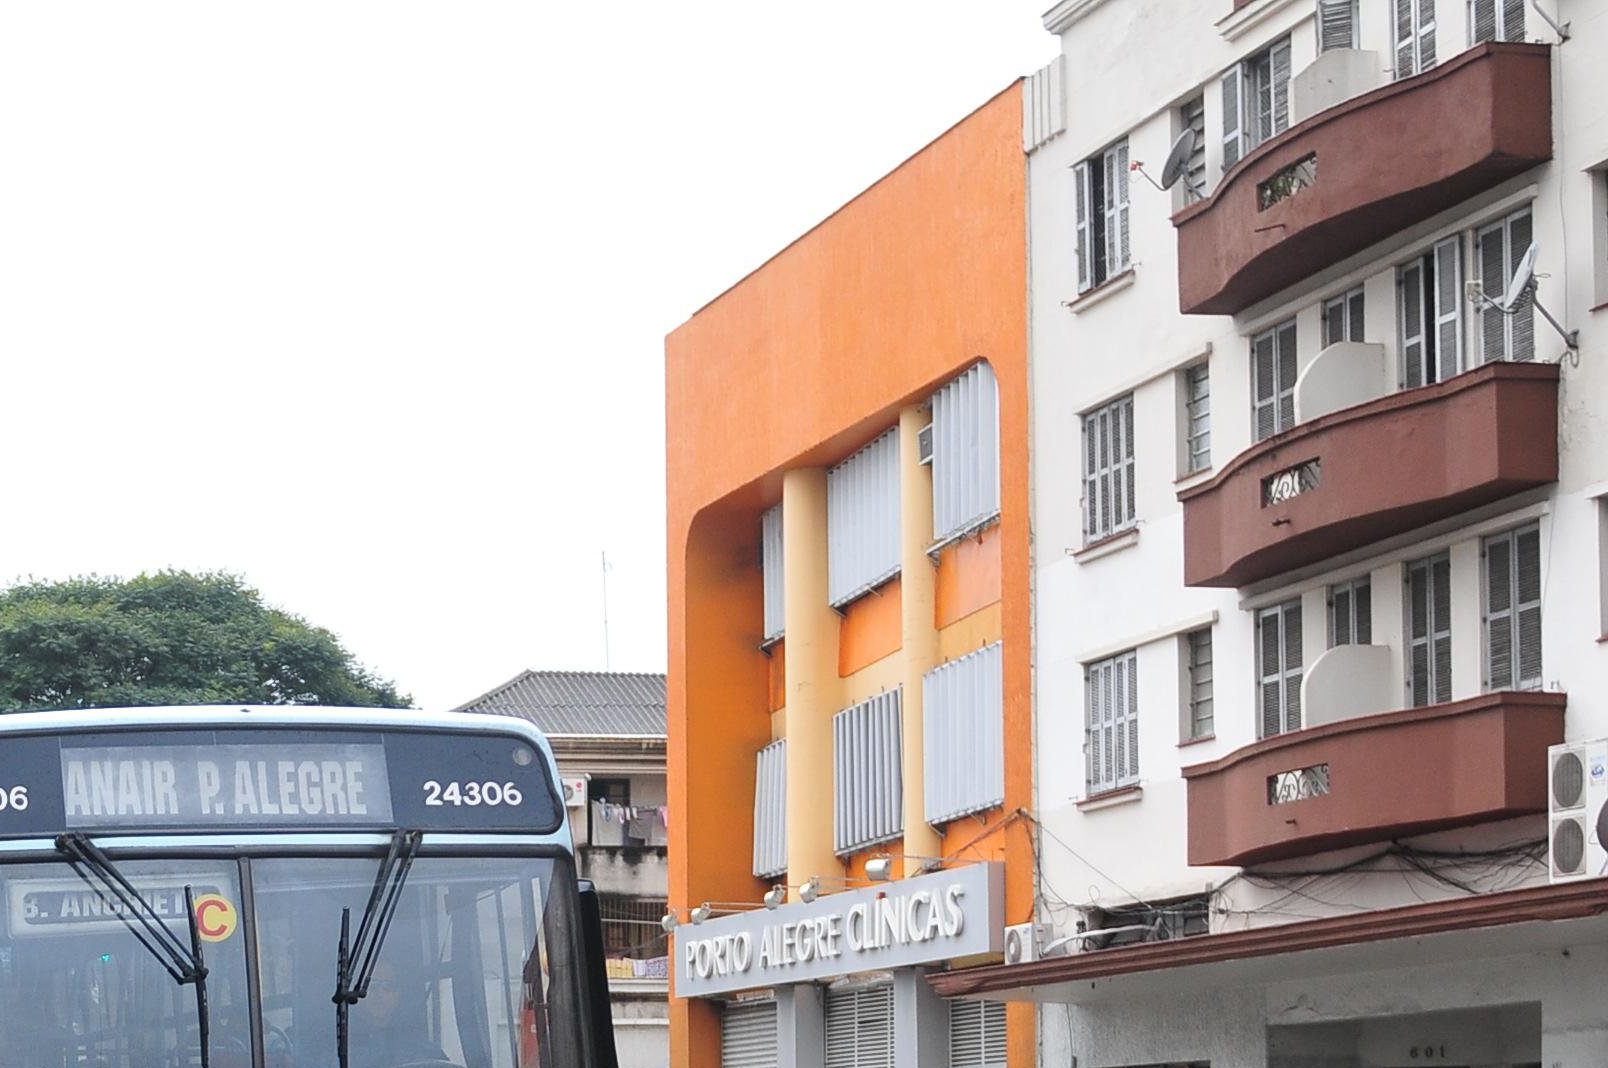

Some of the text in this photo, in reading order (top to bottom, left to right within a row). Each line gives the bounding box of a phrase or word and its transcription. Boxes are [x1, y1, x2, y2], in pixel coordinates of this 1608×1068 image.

[66, 760, 368, 816] ANAIR P. ALEGRE
[423, 780, 523, 807] 24306
[196, 898, 229, 937] C
[685, 884, 965, 980] PORTO ALEGRE CLÍNICAS
